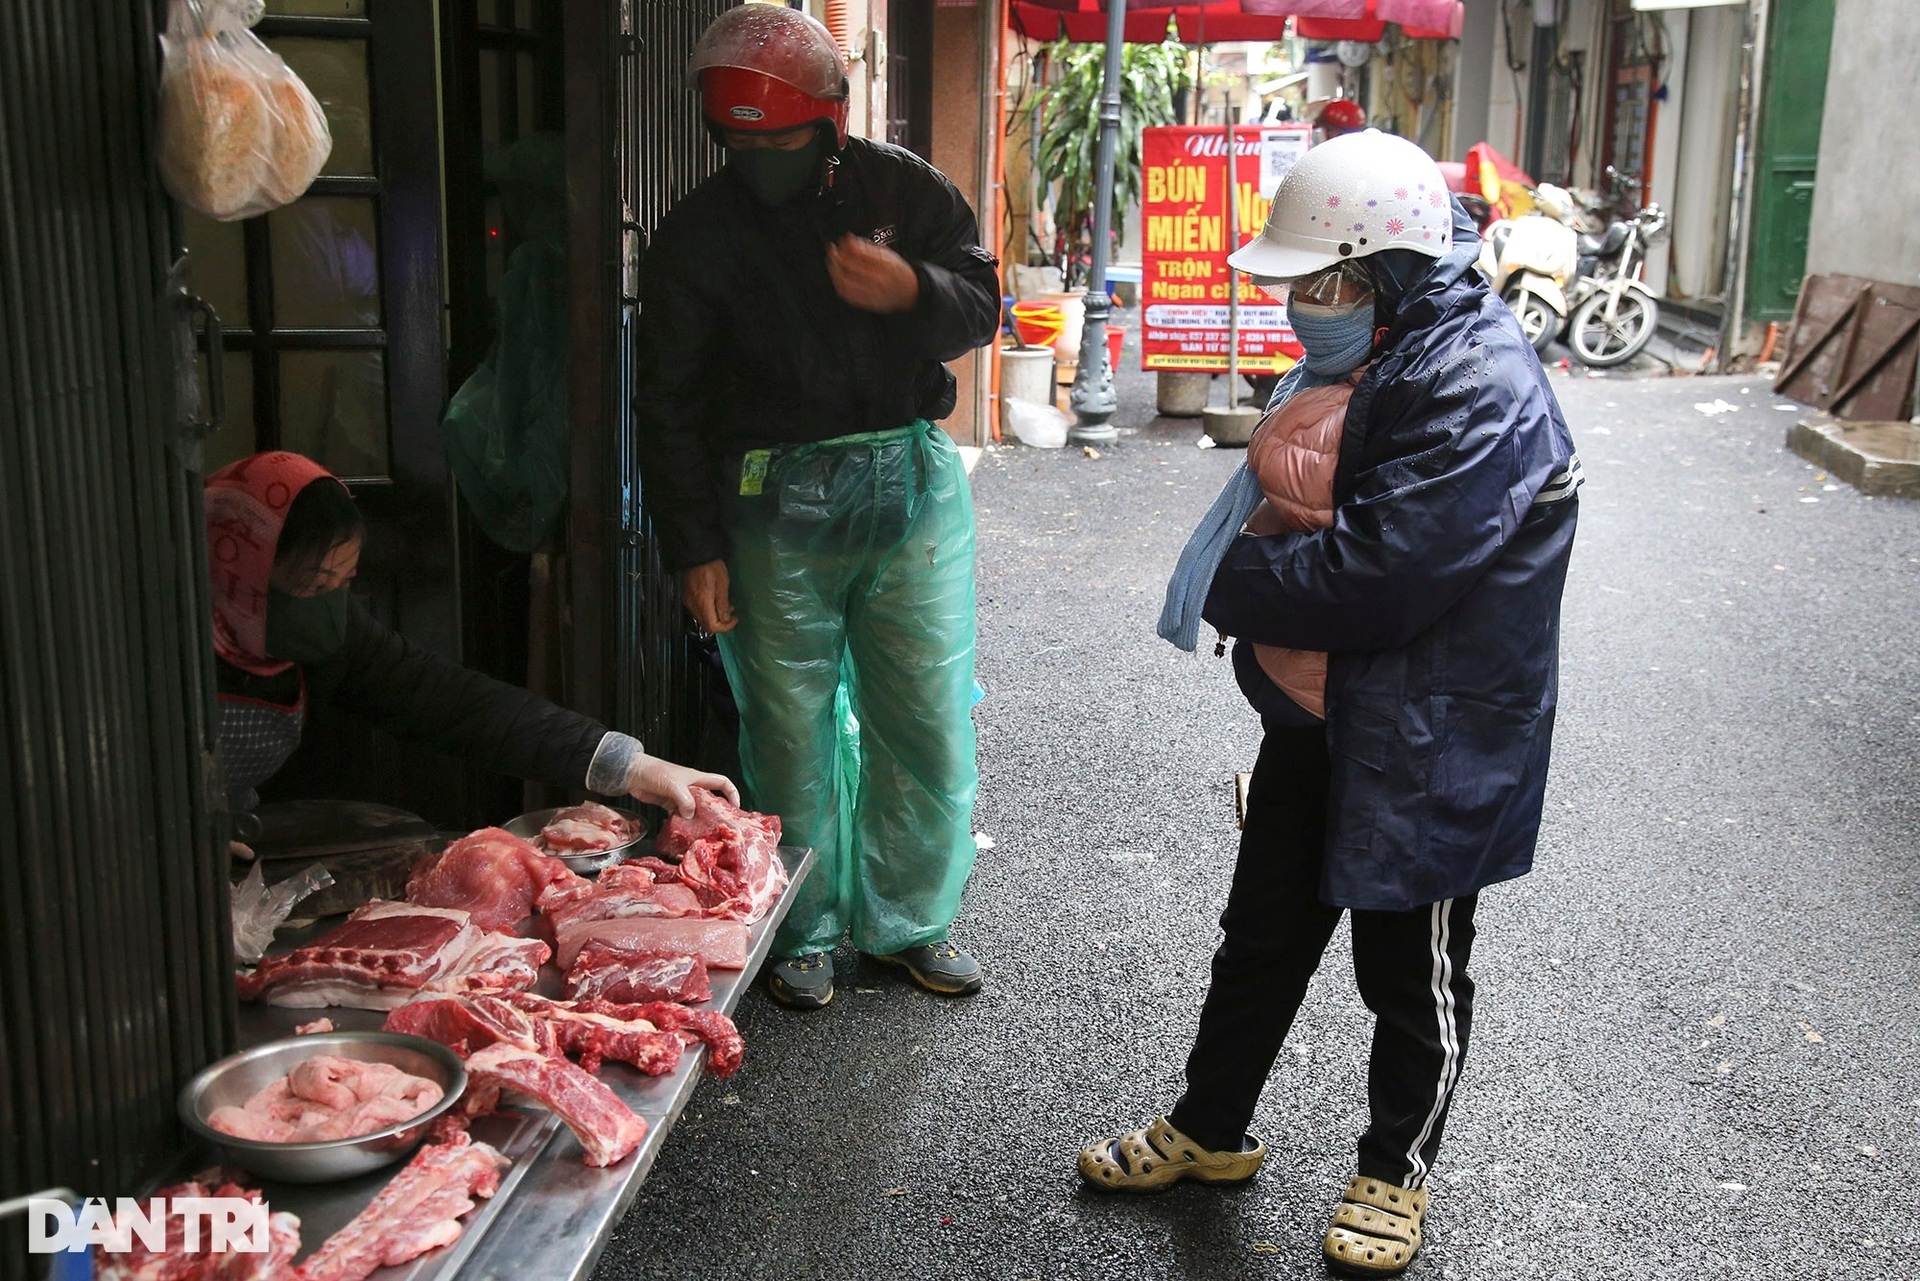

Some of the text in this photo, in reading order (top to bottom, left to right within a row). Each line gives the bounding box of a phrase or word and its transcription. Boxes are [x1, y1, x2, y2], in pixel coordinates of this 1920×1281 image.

[1147, 158, 1206, 203] BÚN
[1147, 204, 1221, 252] MIẾN
[1157, 257, 1212, 281] TRỘN
[1152, 281, 1205, 300] Ngan
